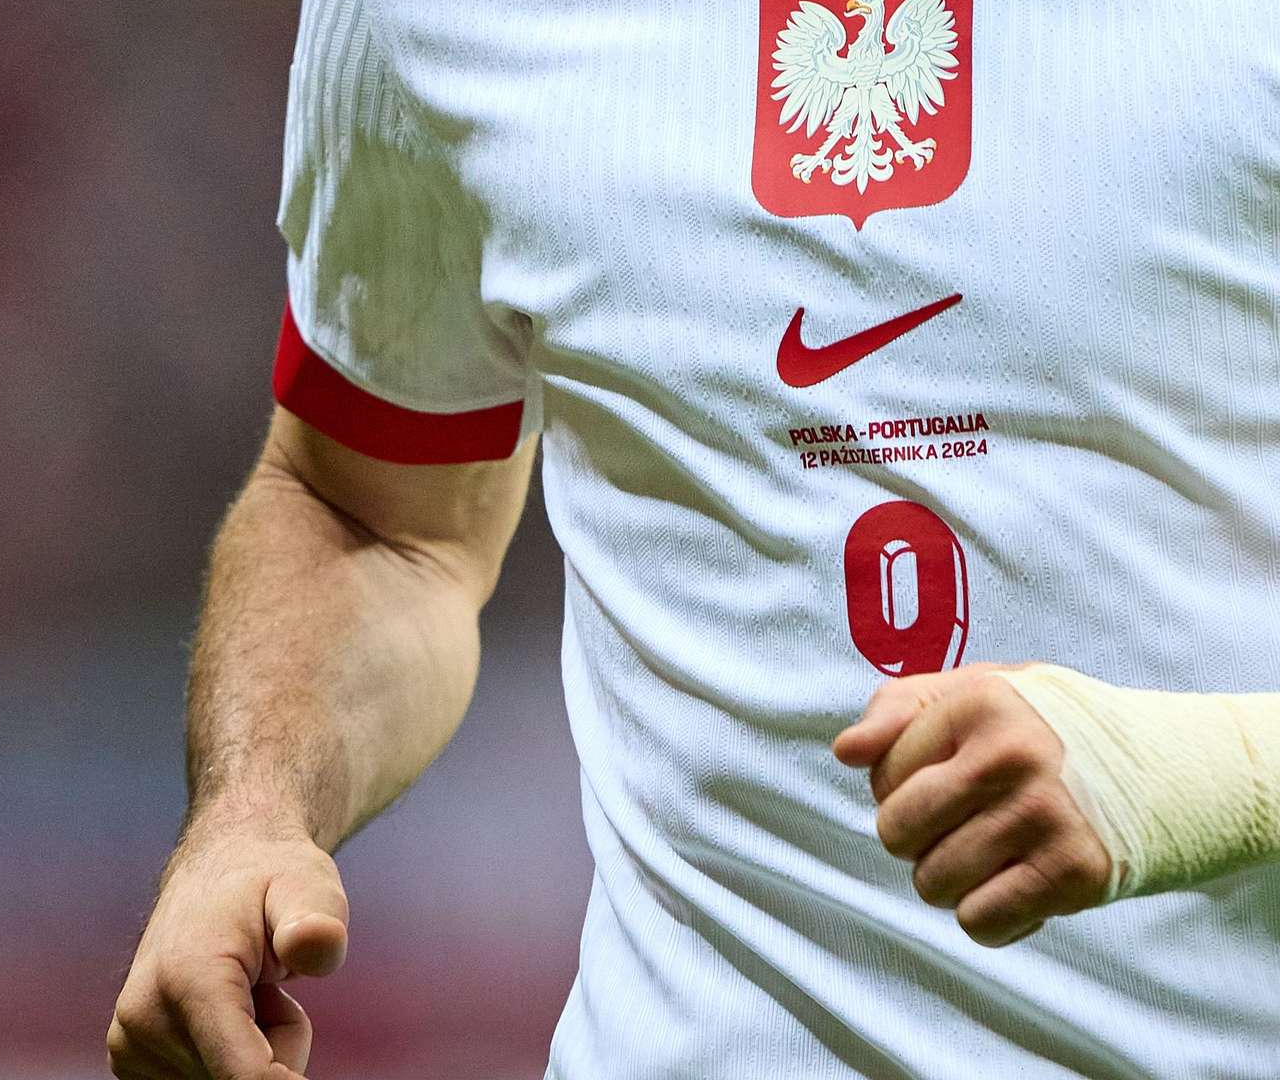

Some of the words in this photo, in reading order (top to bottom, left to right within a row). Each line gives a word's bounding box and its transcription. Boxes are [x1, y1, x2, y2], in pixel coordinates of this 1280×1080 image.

[799, 452, 818, 469] 12
[820, 444, 938, 467] PAŹDZIERNIKA
[941, 439, 988, 460] 2024
[844, 500, 970, 678] 9
